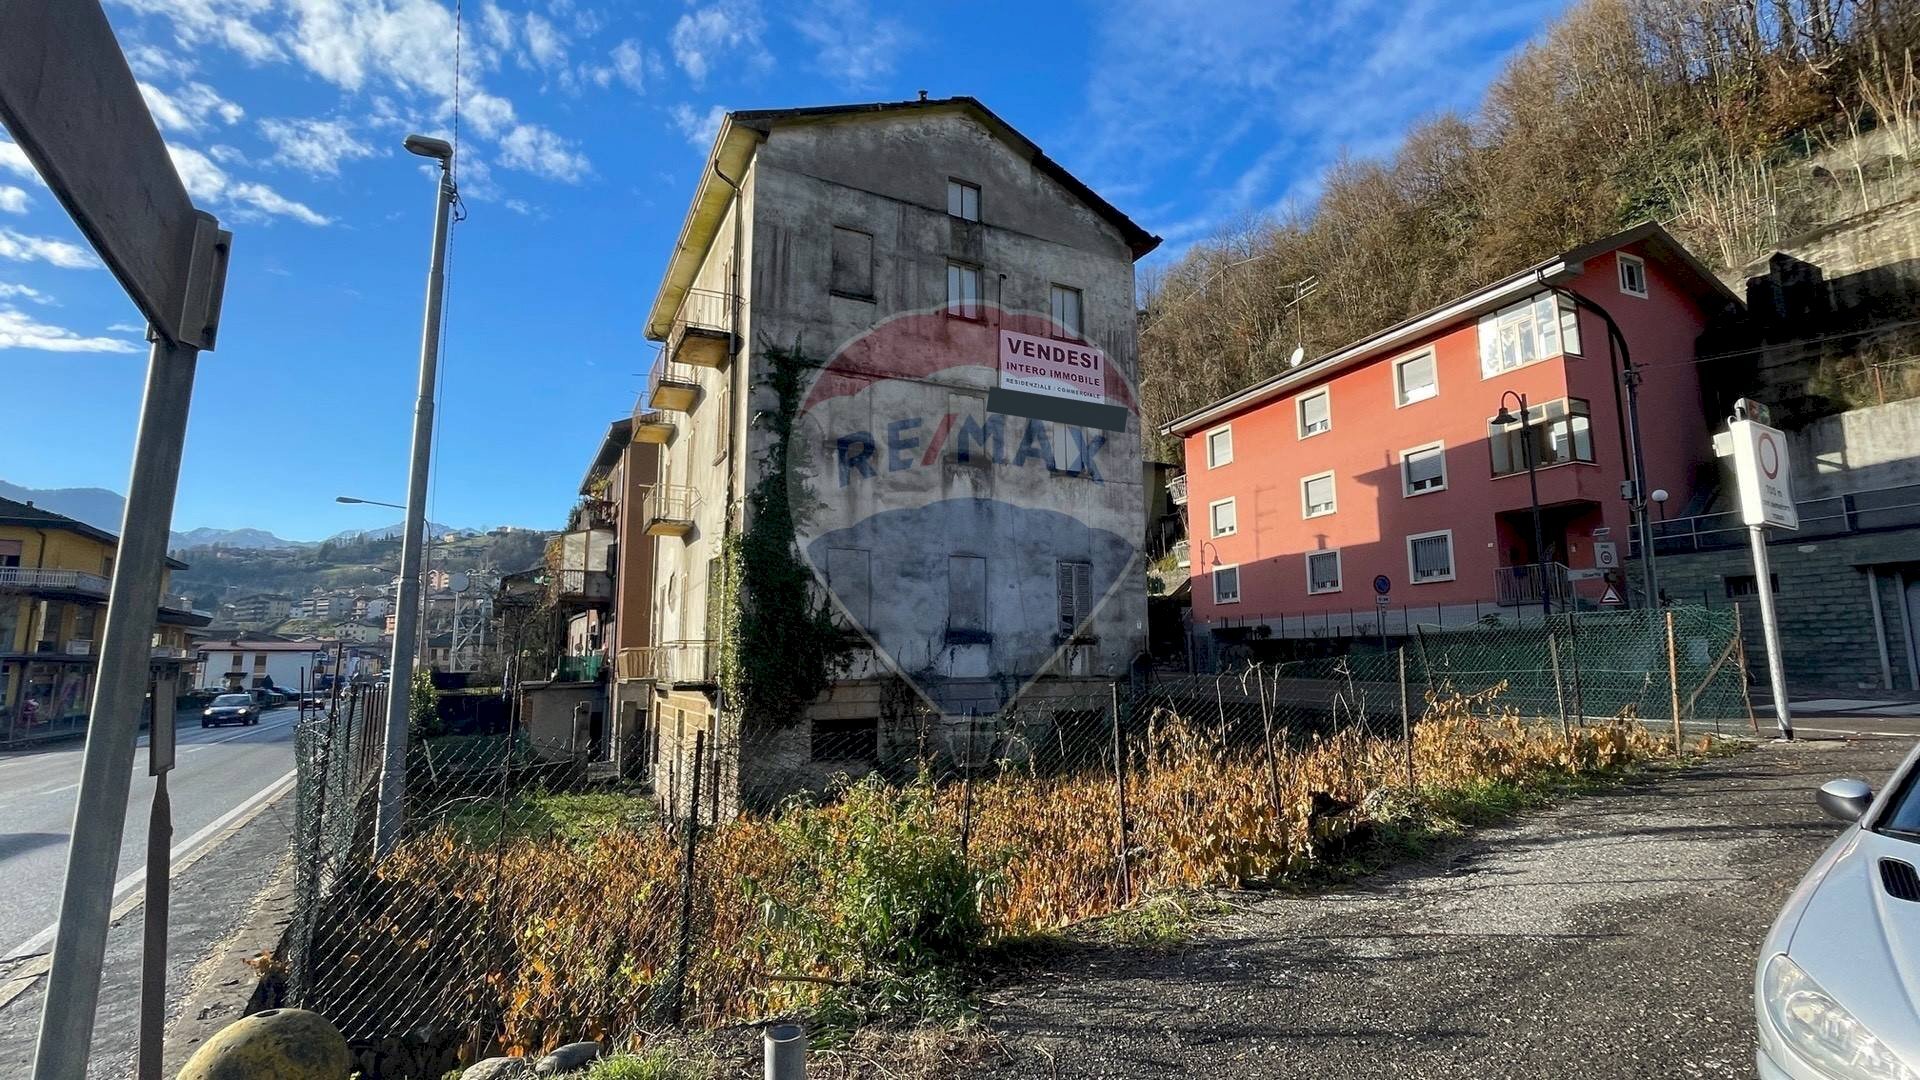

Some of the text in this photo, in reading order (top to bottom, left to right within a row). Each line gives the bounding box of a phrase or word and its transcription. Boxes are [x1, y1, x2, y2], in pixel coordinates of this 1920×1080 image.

[1007, 337, 1099, 370] VENDESI
[1006, 361, 1100, 387] INTERO IMMOBILE
[1006, 378, 1051, 391] RESIDENZIALE
[1057, 386, 1100, 399] COMMERCIALE
